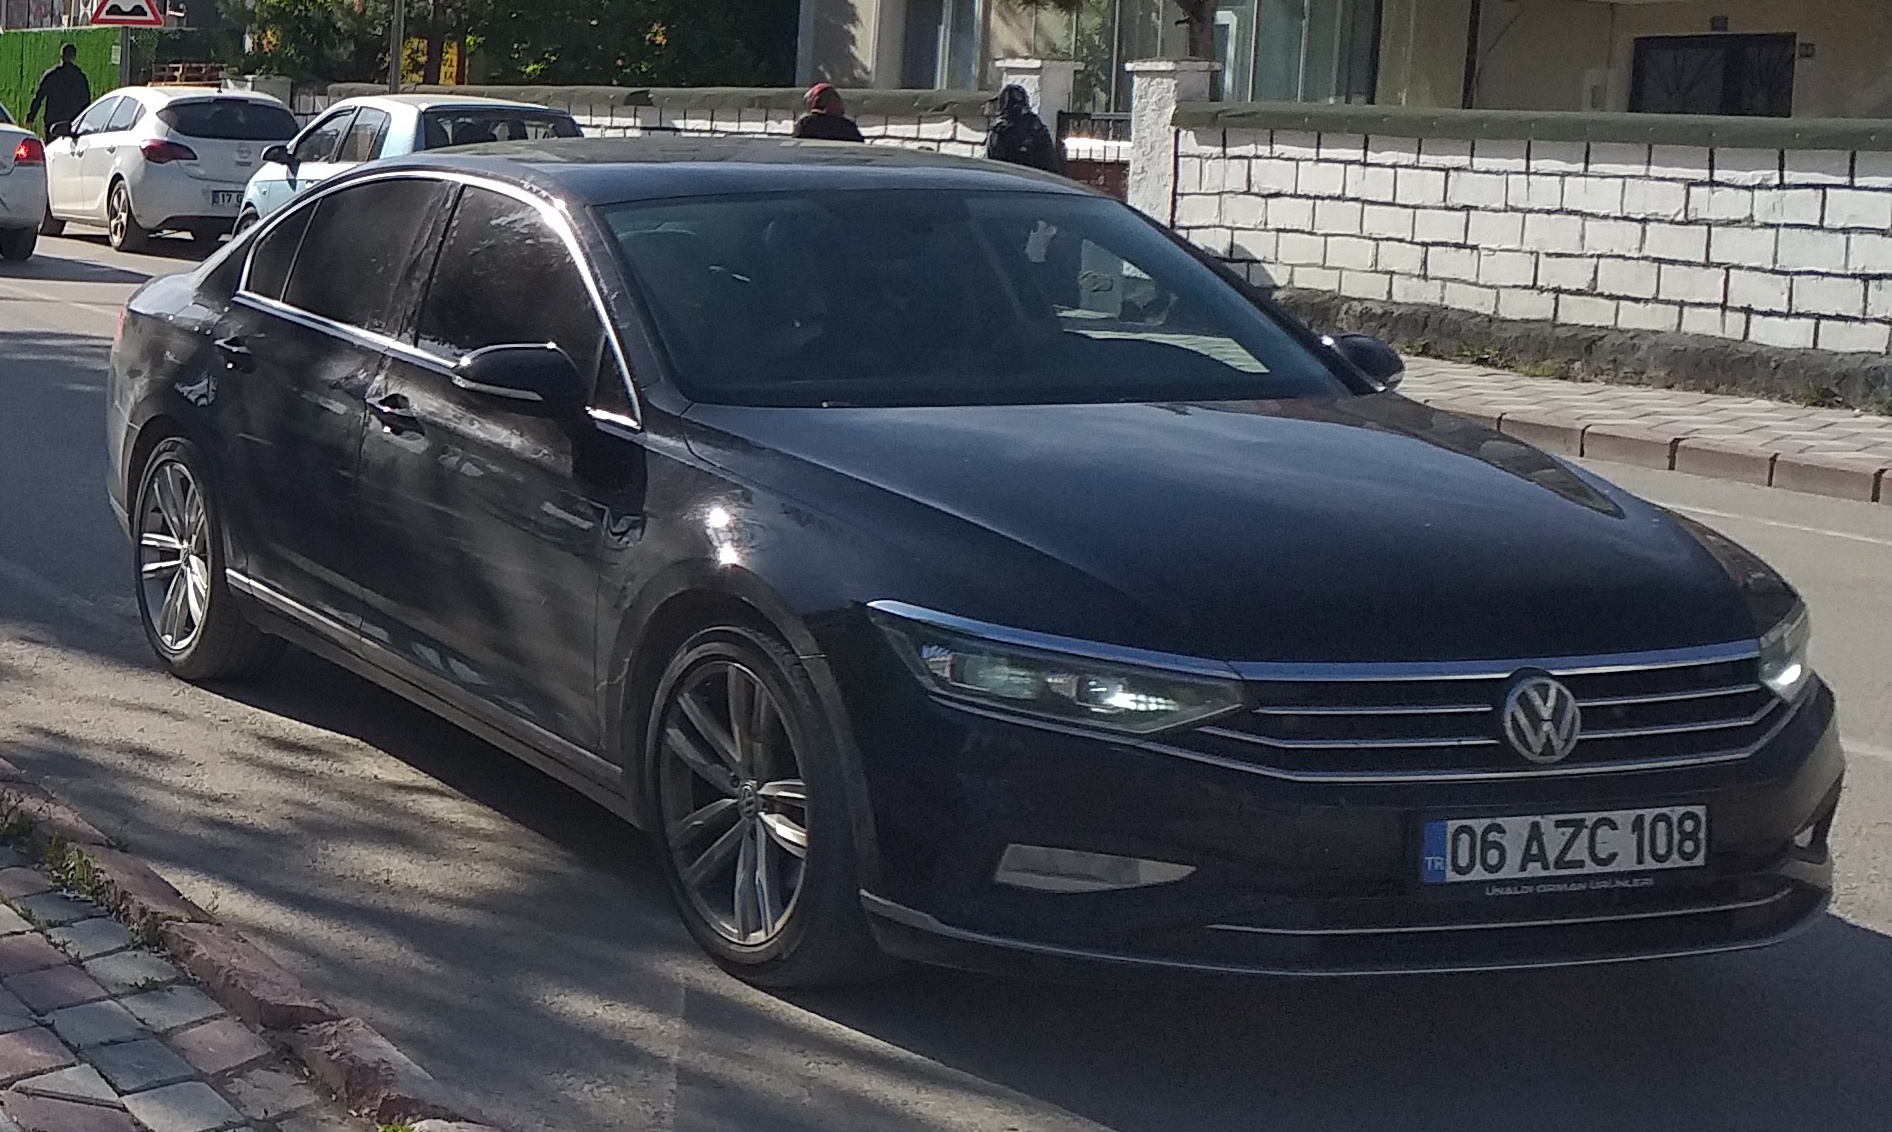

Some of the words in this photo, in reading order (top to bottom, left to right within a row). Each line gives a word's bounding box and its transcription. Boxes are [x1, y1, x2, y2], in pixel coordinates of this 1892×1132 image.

[221, 193, 232, 203] 17
[1451, 822, 1507, 876] 06
[1519, 816, 1619, 873] AZC
[1631, 810, 1701, 866] 108
[1425, 856, 1445, 871] TR
